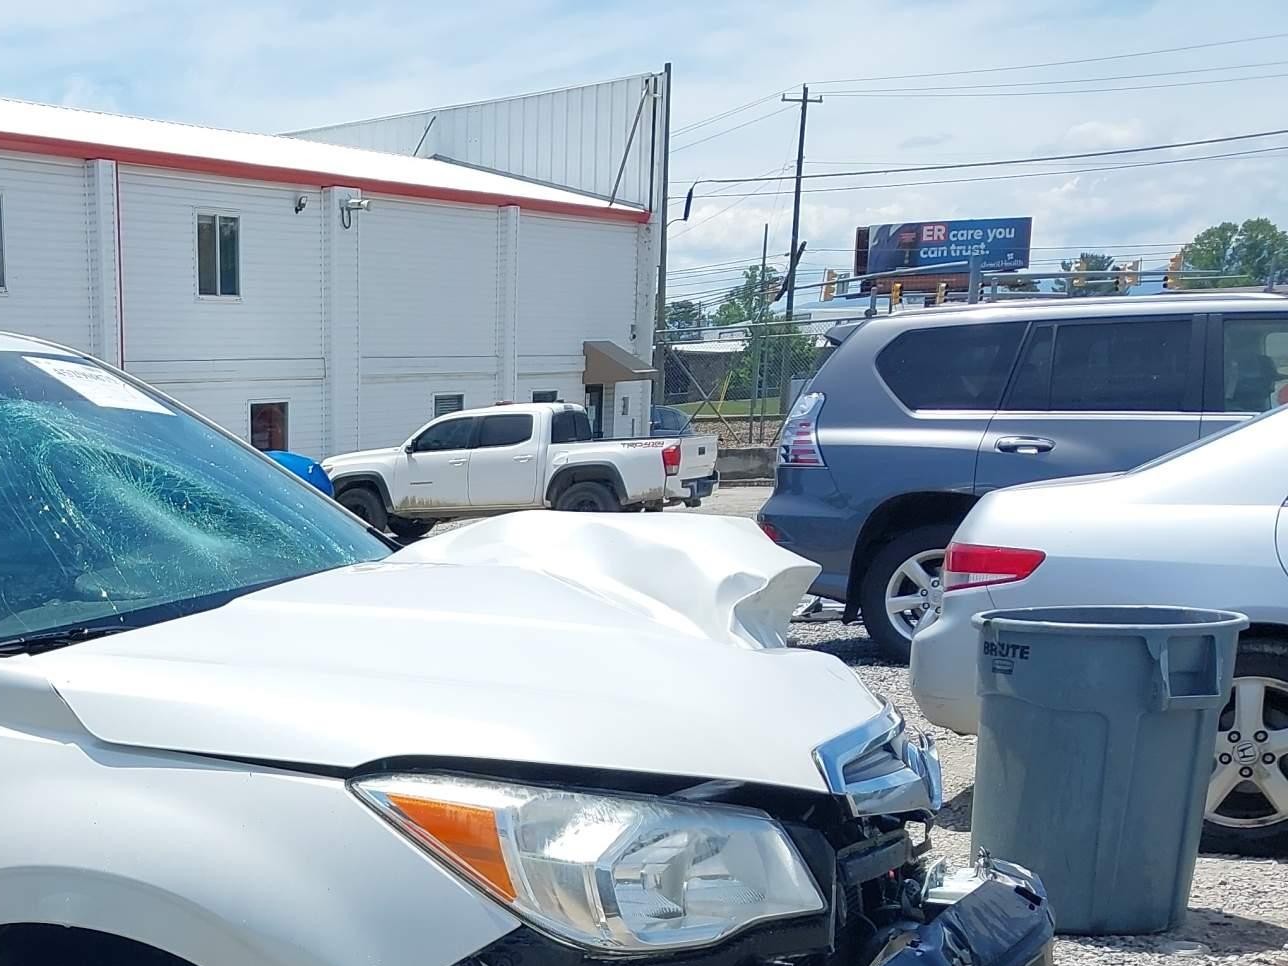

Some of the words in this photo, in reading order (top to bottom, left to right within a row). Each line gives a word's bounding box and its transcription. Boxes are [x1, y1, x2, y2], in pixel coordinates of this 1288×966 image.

[922, 226, 946, 241] ER
[949, 229, 983, 241] care
[987, 227, 1015, 242] you
[920, 245, 948, 258] can
[950, 242, 990, 257] trust.
[983, 641, 1030, 660] BRUTE
